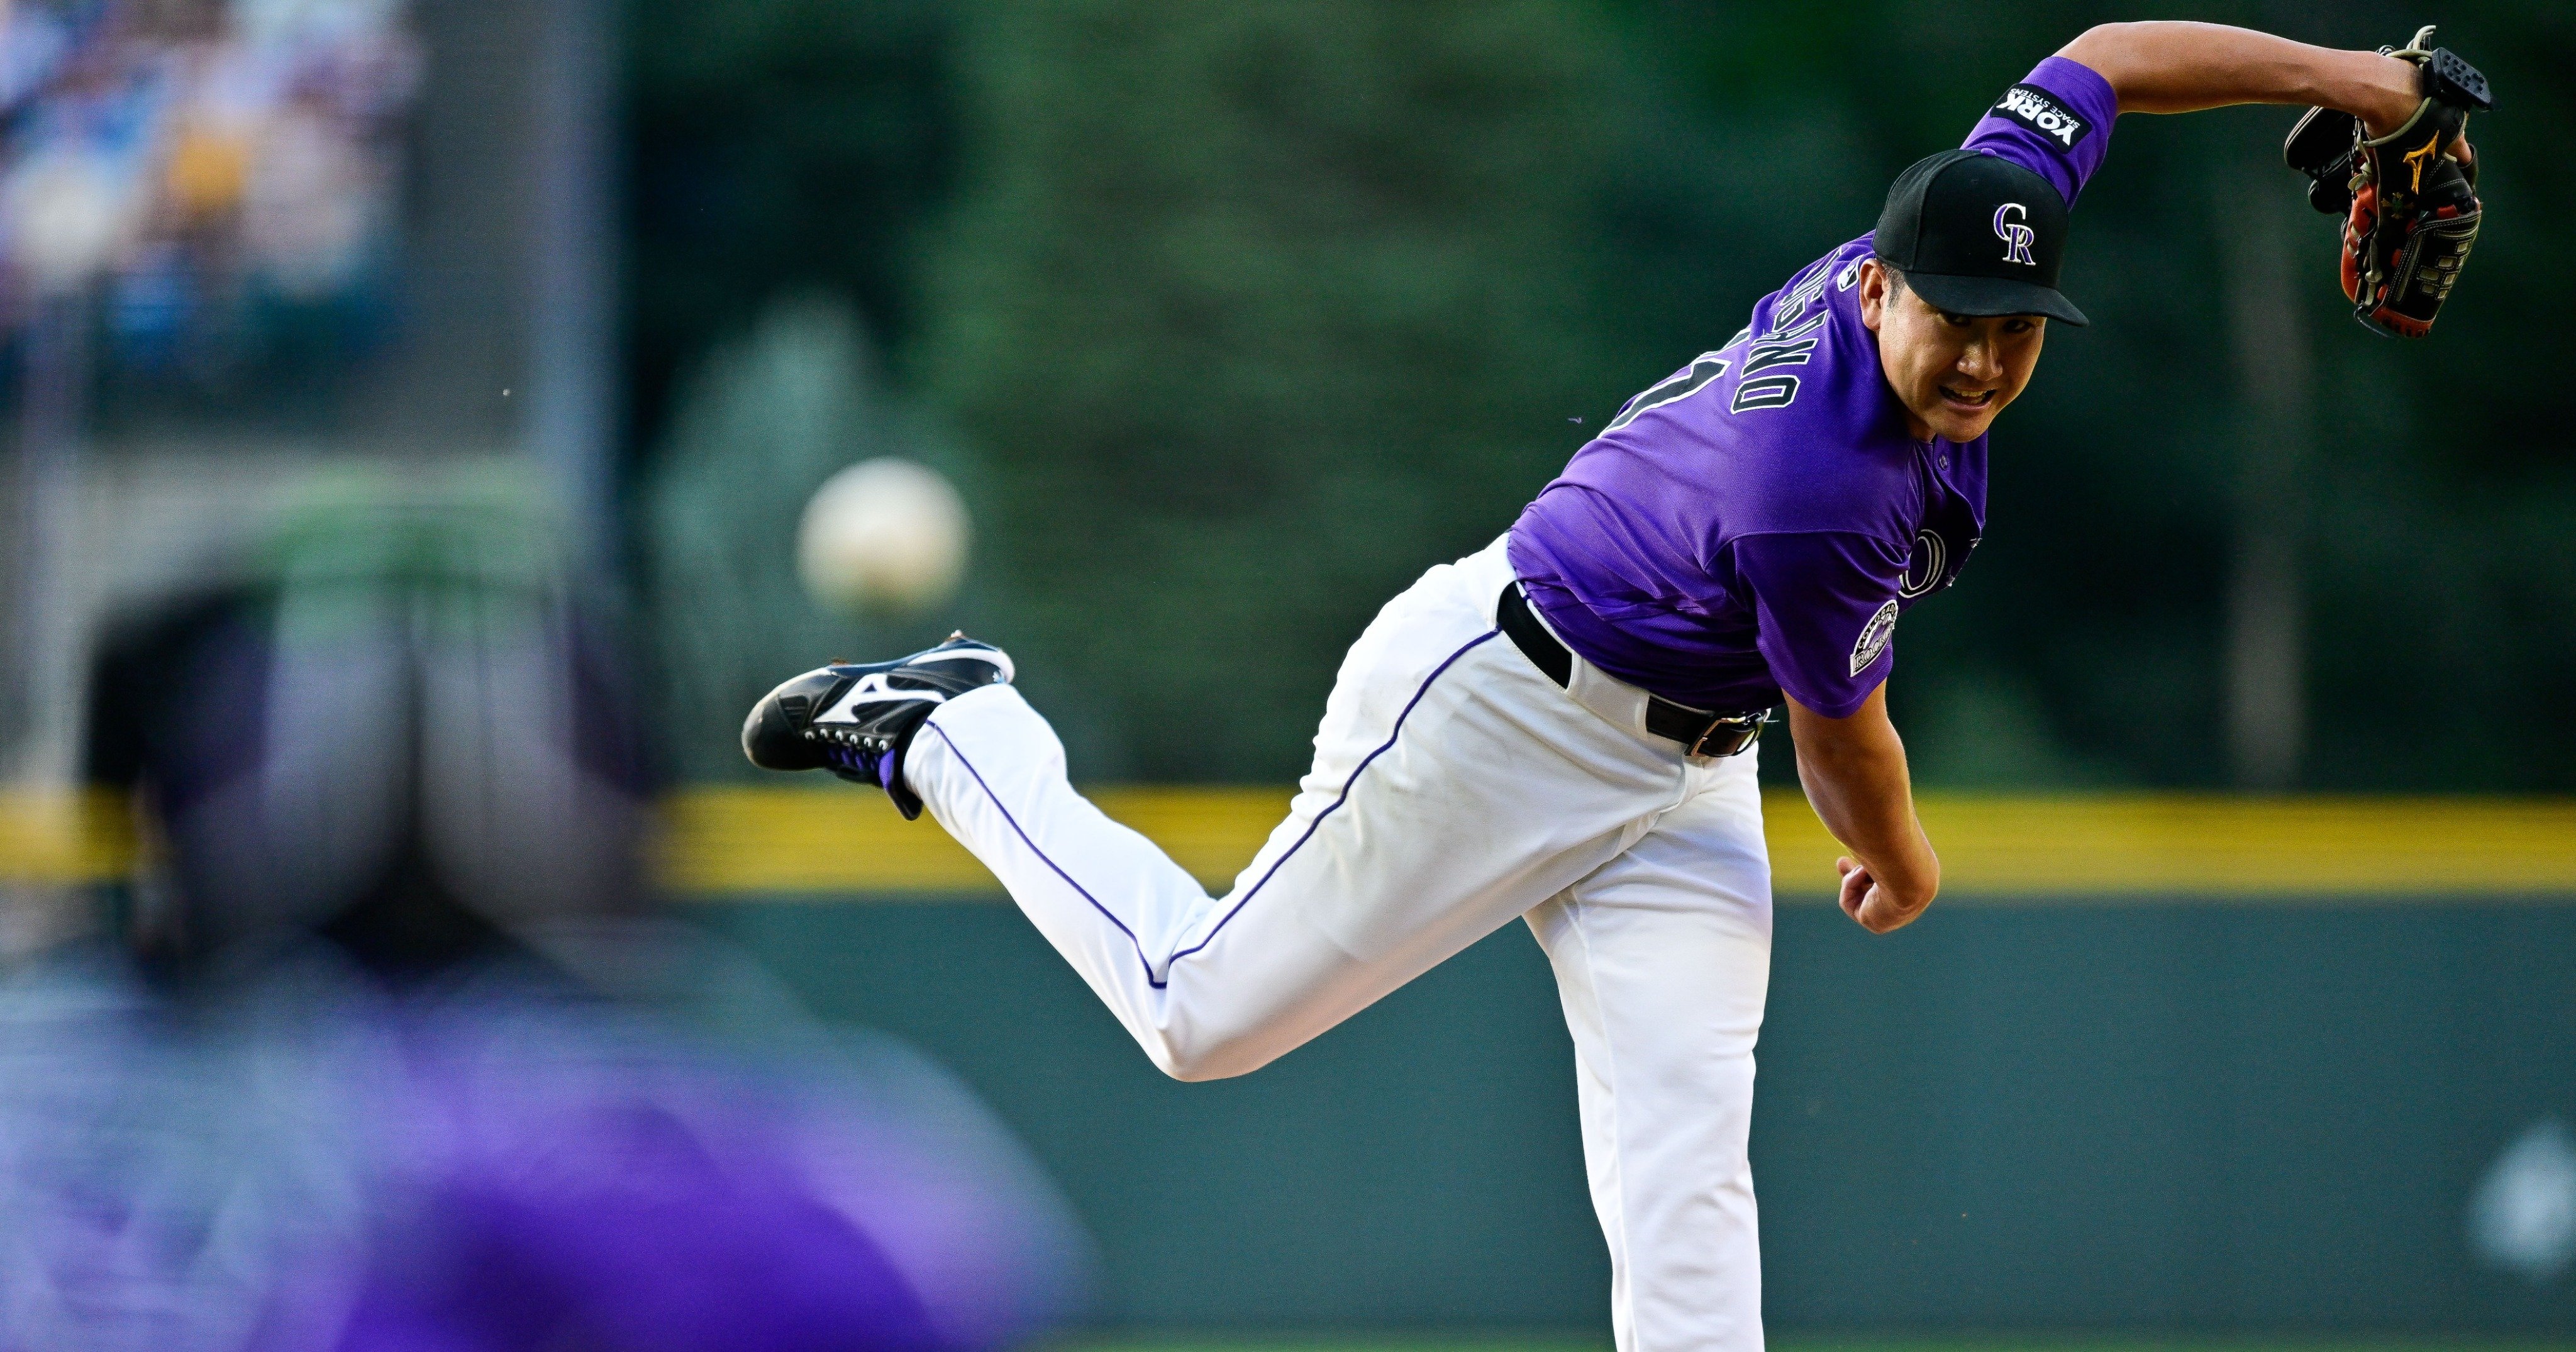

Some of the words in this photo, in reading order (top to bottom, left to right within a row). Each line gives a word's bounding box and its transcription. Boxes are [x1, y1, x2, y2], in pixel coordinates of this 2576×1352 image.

[2009, 88, 2051, 108] SYSTEMS
[1996, 93, 2075, 146] YORK
[2050, 106, 2081, 129] SPACE
[1993, 202, 2036, 266] CR
